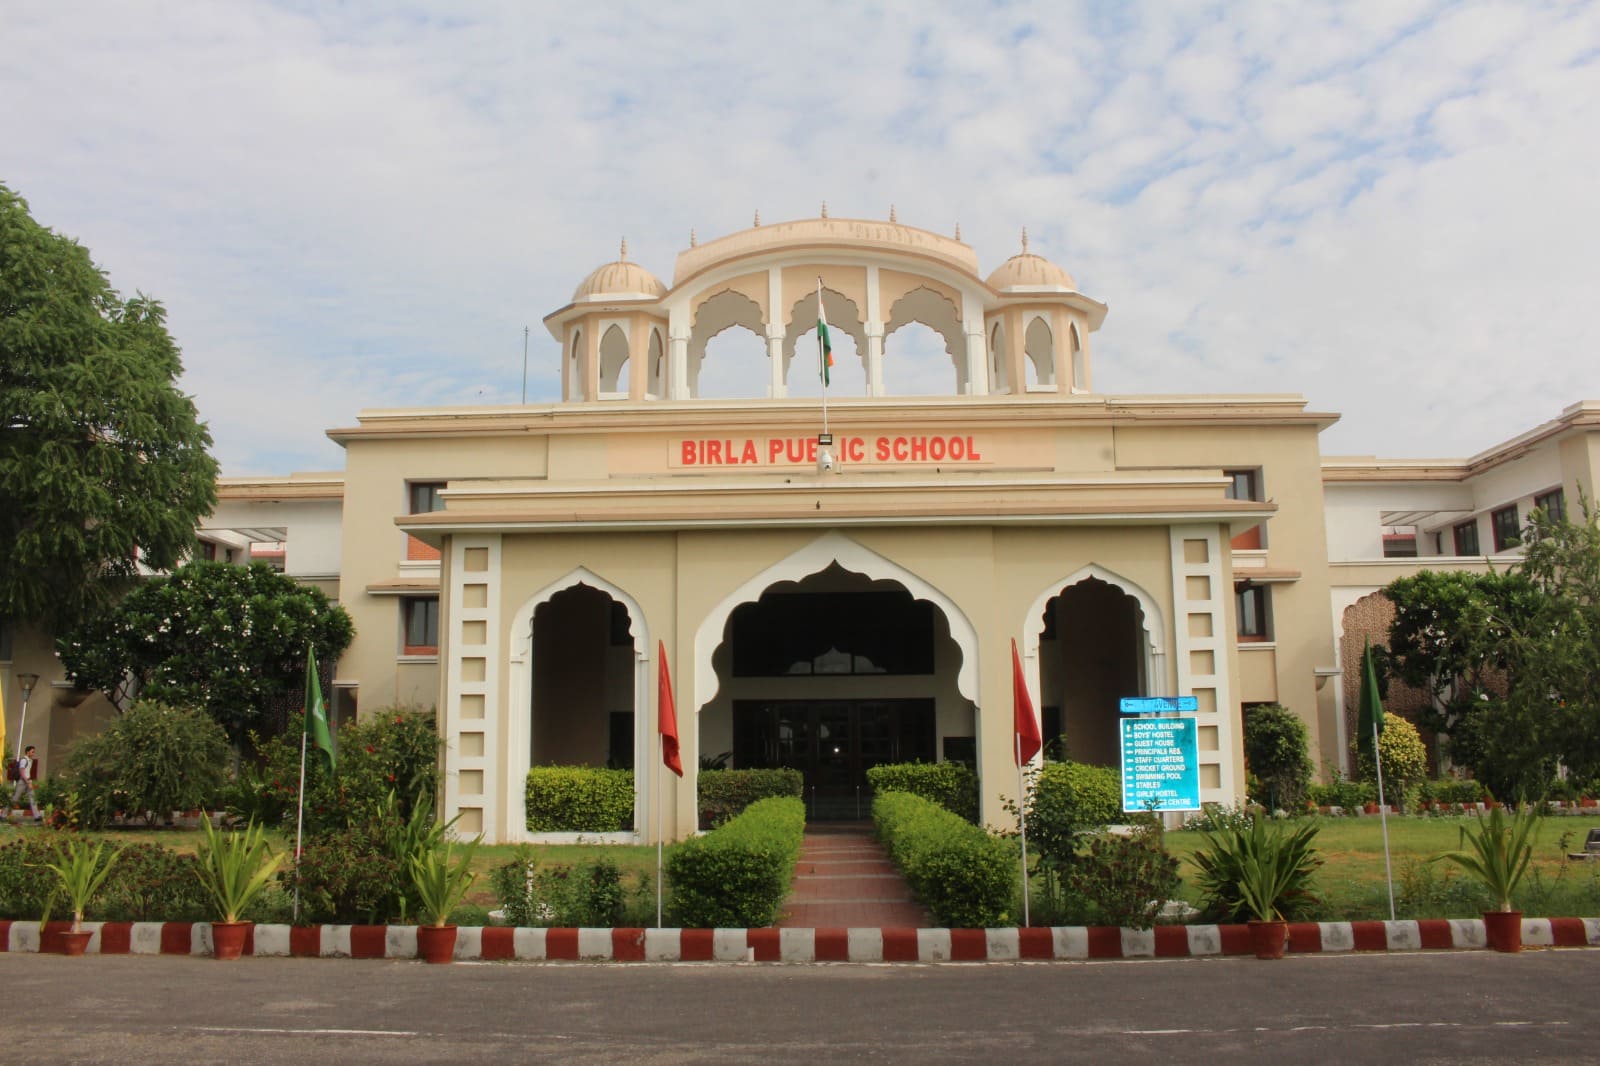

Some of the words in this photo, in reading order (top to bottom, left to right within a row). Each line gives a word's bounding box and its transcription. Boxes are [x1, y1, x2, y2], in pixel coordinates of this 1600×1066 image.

[682, 439, 758, 465] BIRLA
[769, 437, 865, 464] PUBIC
[876, 436, 981, 462] SCHOOL
[1158, 722, 1185, 730] BUILDING
[1135, 773, 1166, 781] SWIMMING
[1167, 798, 1191, 806] CENTRE
